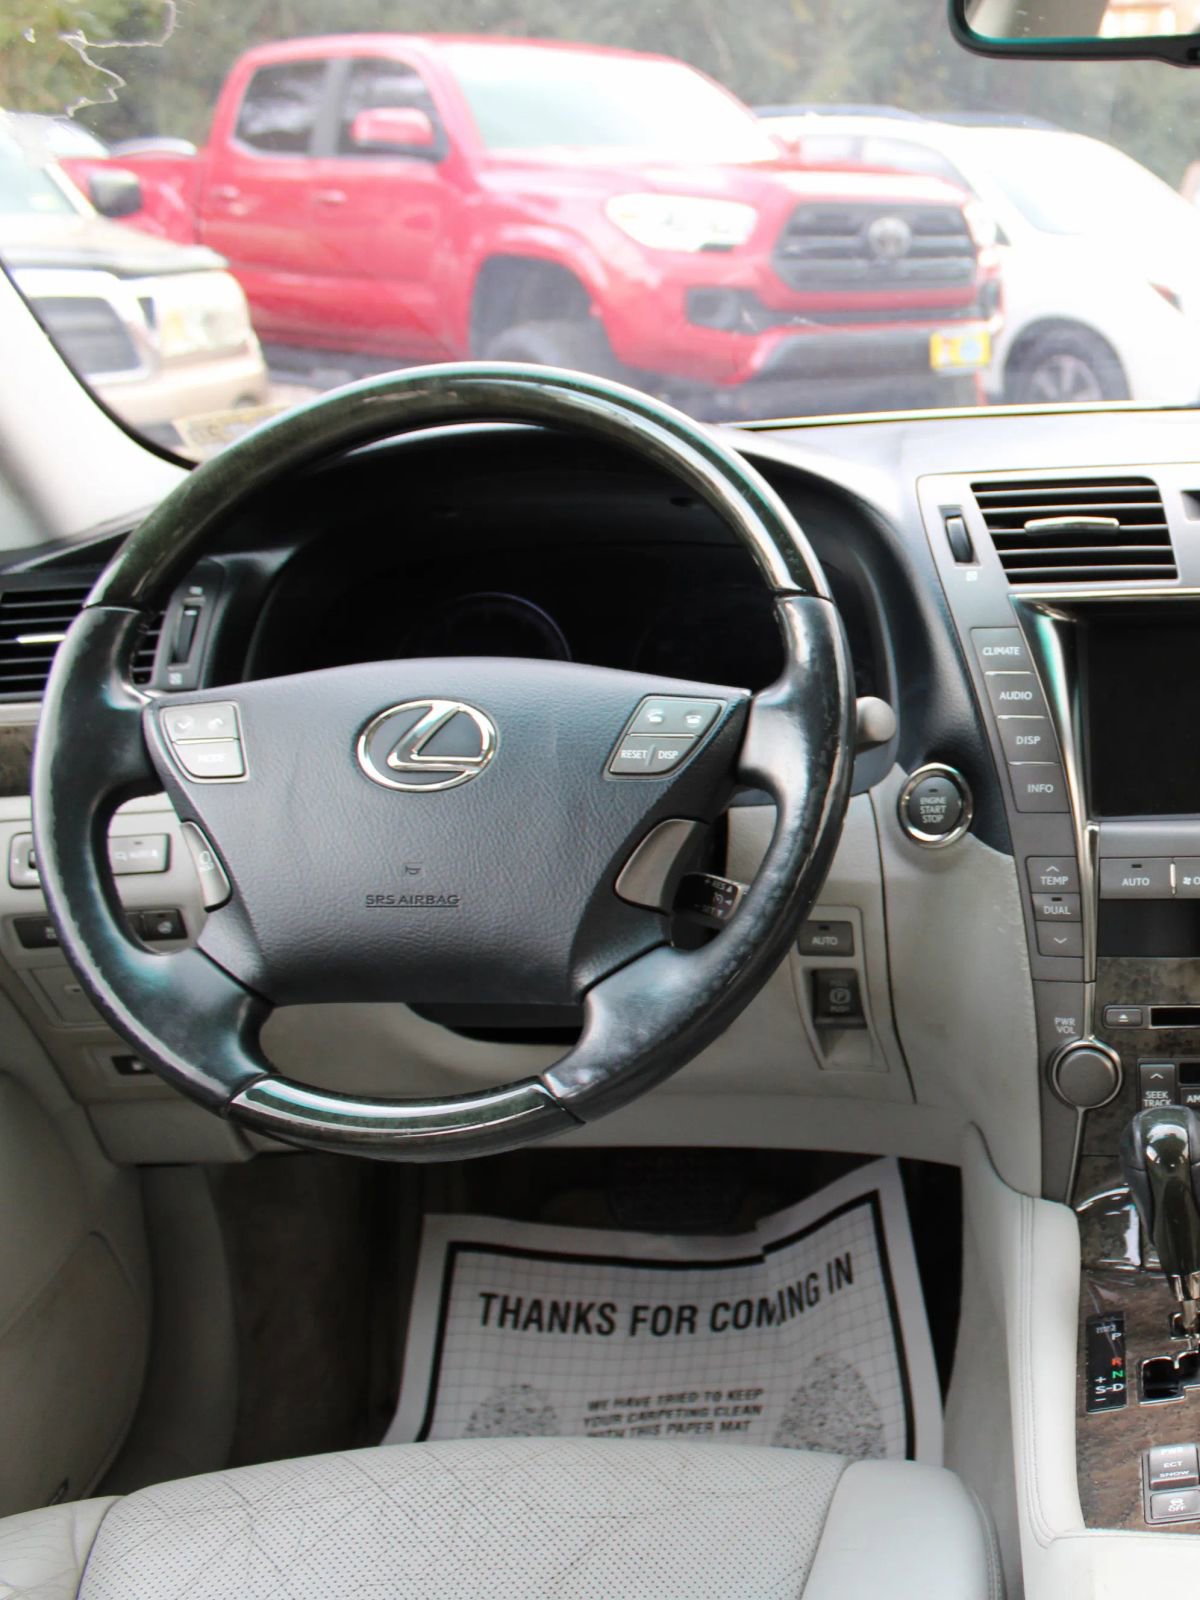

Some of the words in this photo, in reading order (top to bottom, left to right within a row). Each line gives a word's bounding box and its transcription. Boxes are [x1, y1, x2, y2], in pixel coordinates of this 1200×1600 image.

[983, 646, 1021, 656] CLIMATE
[1000, 691, 1032, 701] AUDIO
[1016, 735, 1041, 745] DISP
[621, 749, 648, 759] RESET
[658, 750, 679, 760] DISP
[1027, 783, 1054, 794] INFO
[920, 805, 947, 815] START
[922, 814, 945, 824] STOP
[1040, 876, 1069, 886] TEMP
[1121, 877, 1151, 887] AUTO
[366, 894, 395, 905] SRS
[398, 894, 460, 905] AIRBAG
[1043, 906, 1072, 916] DUAL
[812, 935, 839, 946] AUTO
[1054, 1017, 1076, 1026] PWR
[1056, 1025, 1076, 1035] VOL
[1145, 1090, 1169, 1099] SEEK
[1143, 1099, 1173, 1108] TRACK
[479, 1292, 617, 1336] THANKS
[628, 1304, 698, 1337] FOR
[709, 1272, 821, 1333] COMING
[827, 1251, 855, 1294] IN
[1112, 1332, 1122, 1341] P
[1111, 1356, 1122, 1367] R
[1112, 1370, 1124, 1379] N
[704, 1390, 722, 1403] TO
[727, 1388, 764, 1402] KEEP
[626, 1407, 709, 1424] CARPETING
[714, 1405, 764, 1418] CLEAN
[666, 1421, 714, 1436] PAPER
[720, 1420, 751, 1434] MAT
[1163, 1460, 1183, 1469] ECT
[1160, 1470, 1190, 1478] SNOW
